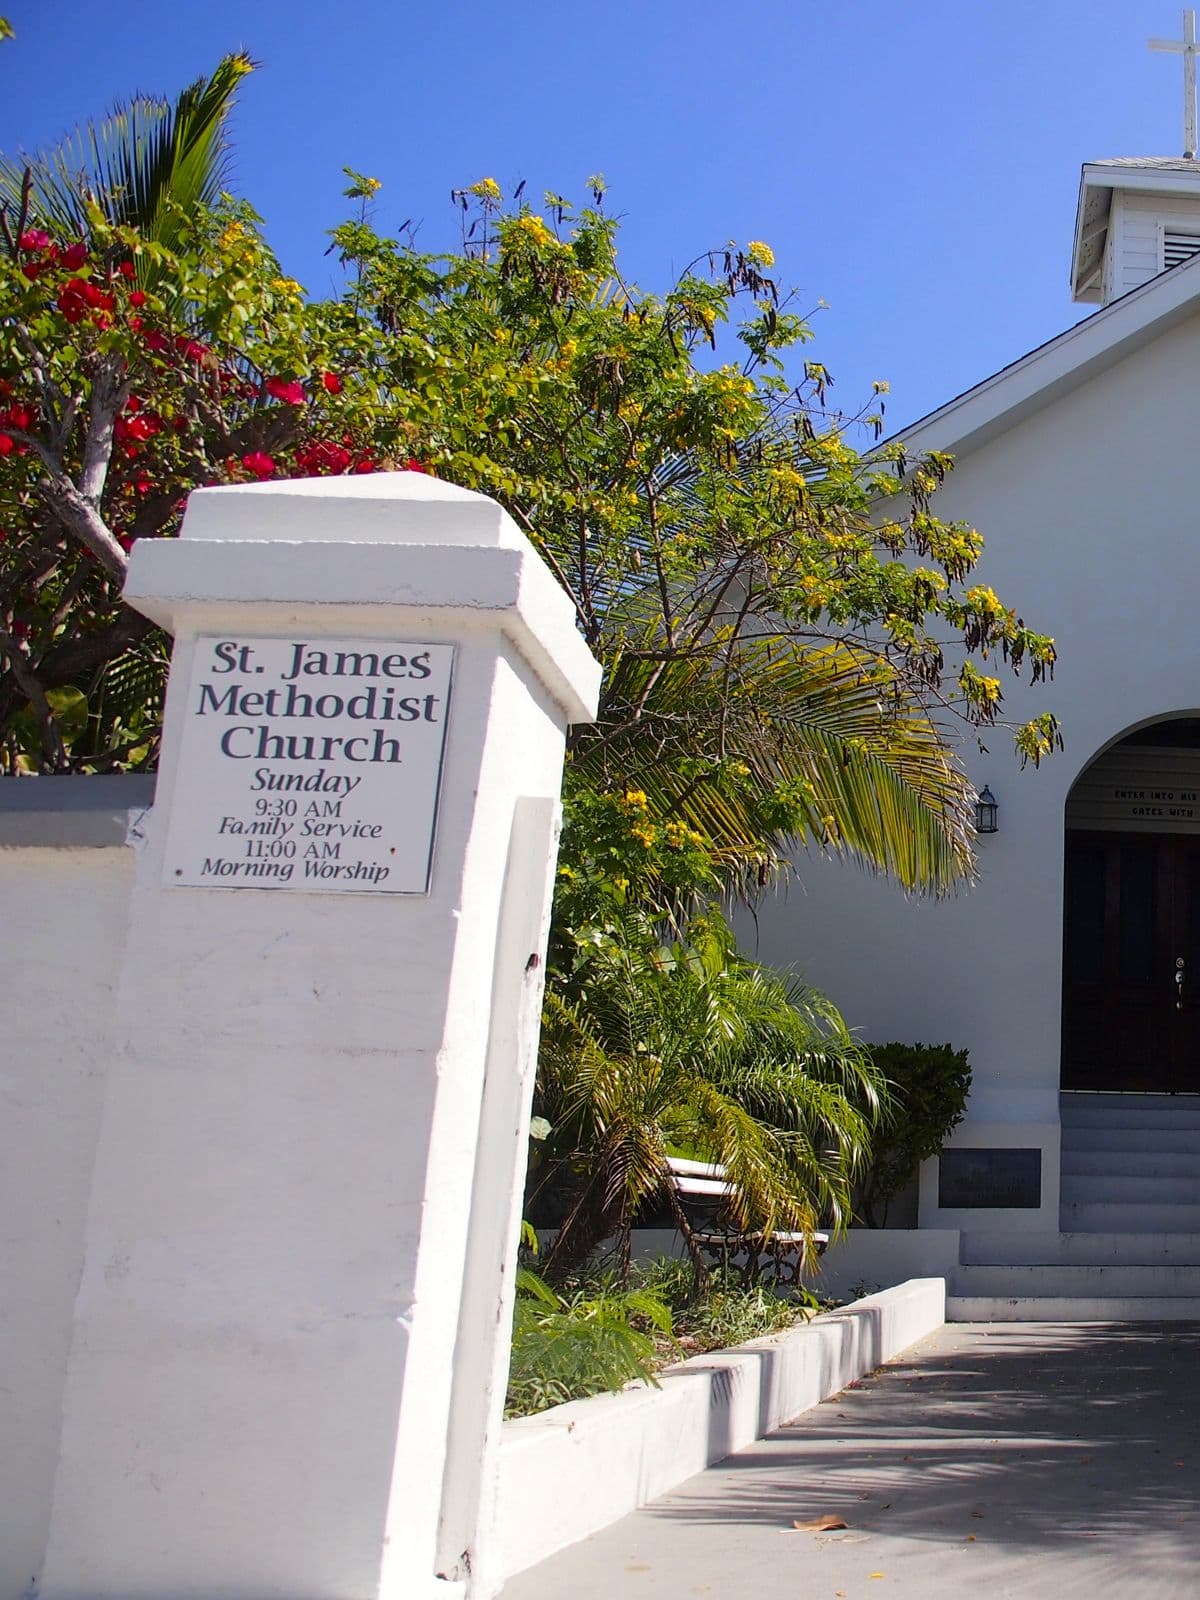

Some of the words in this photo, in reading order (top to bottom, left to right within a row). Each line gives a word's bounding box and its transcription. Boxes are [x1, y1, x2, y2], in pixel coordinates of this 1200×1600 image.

[212, 642, 265, 674] St.
[281, 643, 432, 679] James
[195, 684, 440, 722] Methodist
[220, 725, 402, 763] Church
[250, 767, 361, 798] Sunday
[255, 798, 298, 817] 9:30
[304, 800, 342, 818] AM
[1115, 790, 1145, 799] ENTER
[1151, 791, 1174, 800] INTO
[1181, 792, 1197, 801] HIS
[1132, 807, 1163, 816] GATES
[1169, 808, 1193, 817] WITH
[218, 816, 294, 840] Family
[300, 818, 383, 839] Service
[245, 840, 297, 858] 11:00
[303, 841, 341, 859] AM
[200, 857, 294, 882] Morning
[304, 860, 390, 884] Worship
